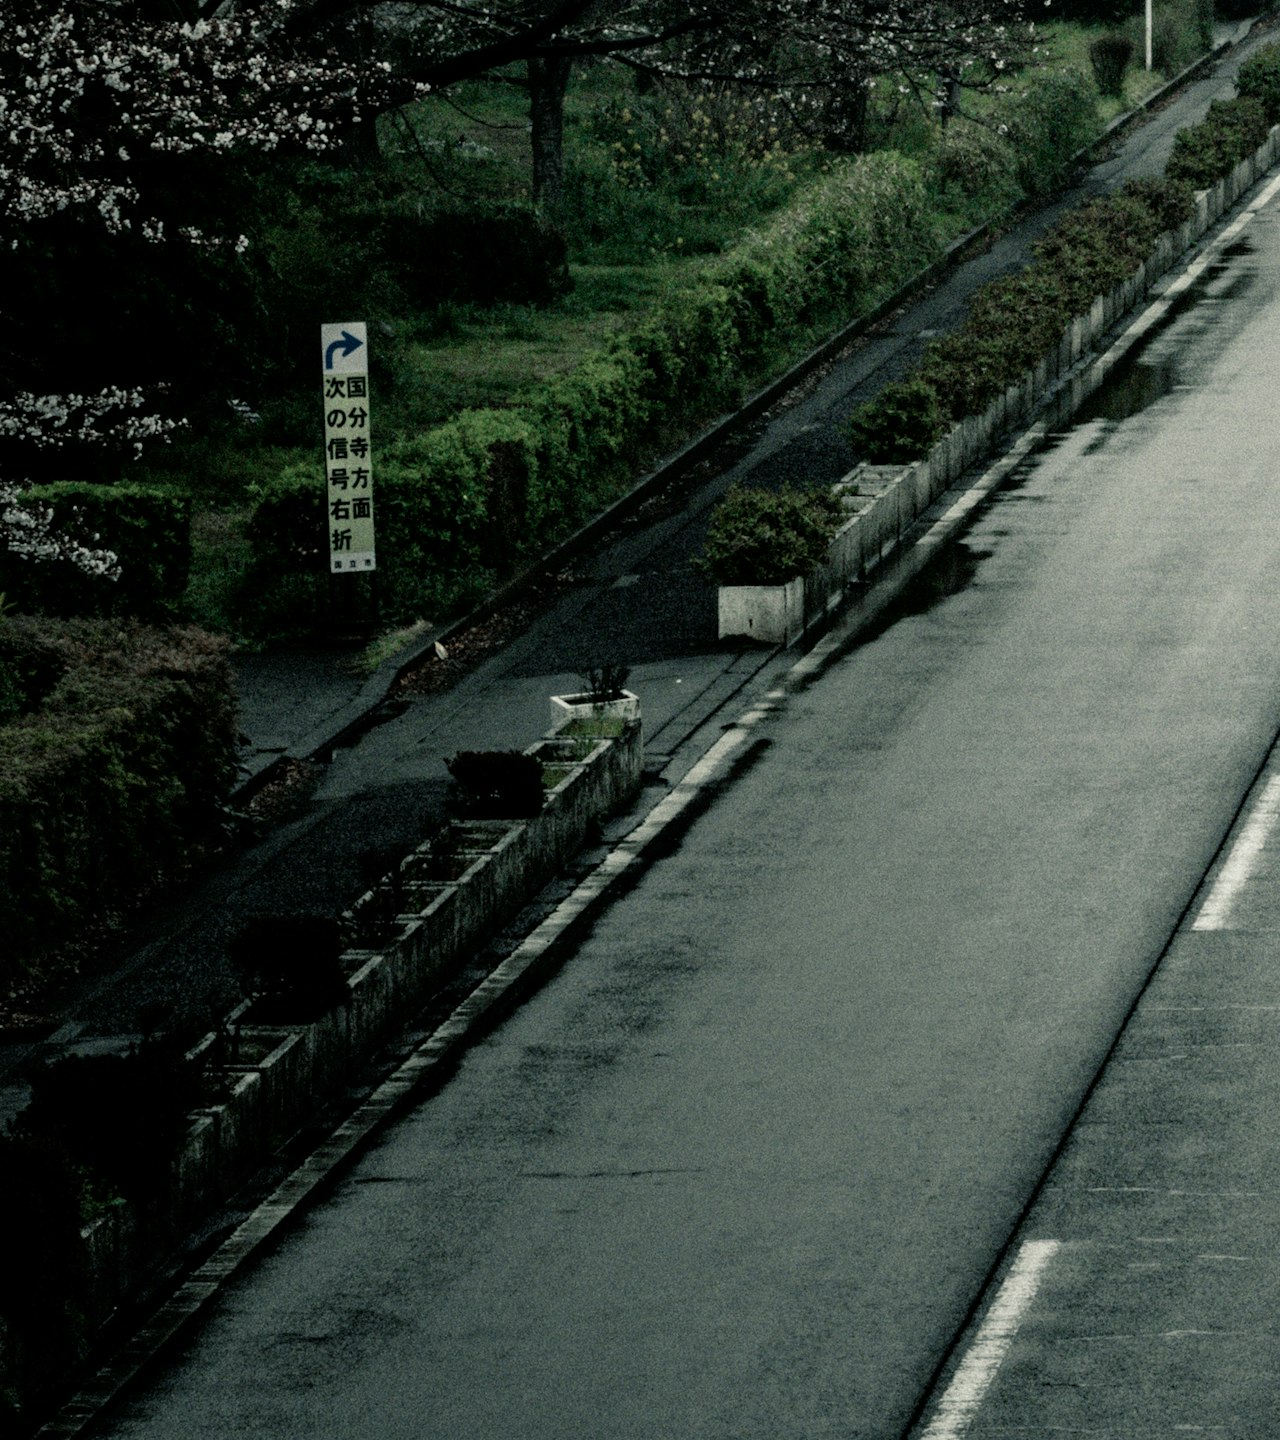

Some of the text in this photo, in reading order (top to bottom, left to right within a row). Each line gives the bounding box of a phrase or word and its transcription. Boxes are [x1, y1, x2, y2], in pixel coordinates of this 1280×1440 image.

[325, 378, 351, 551] 次の信号右折
[347, 377, 370, 519] 国分寺方面
